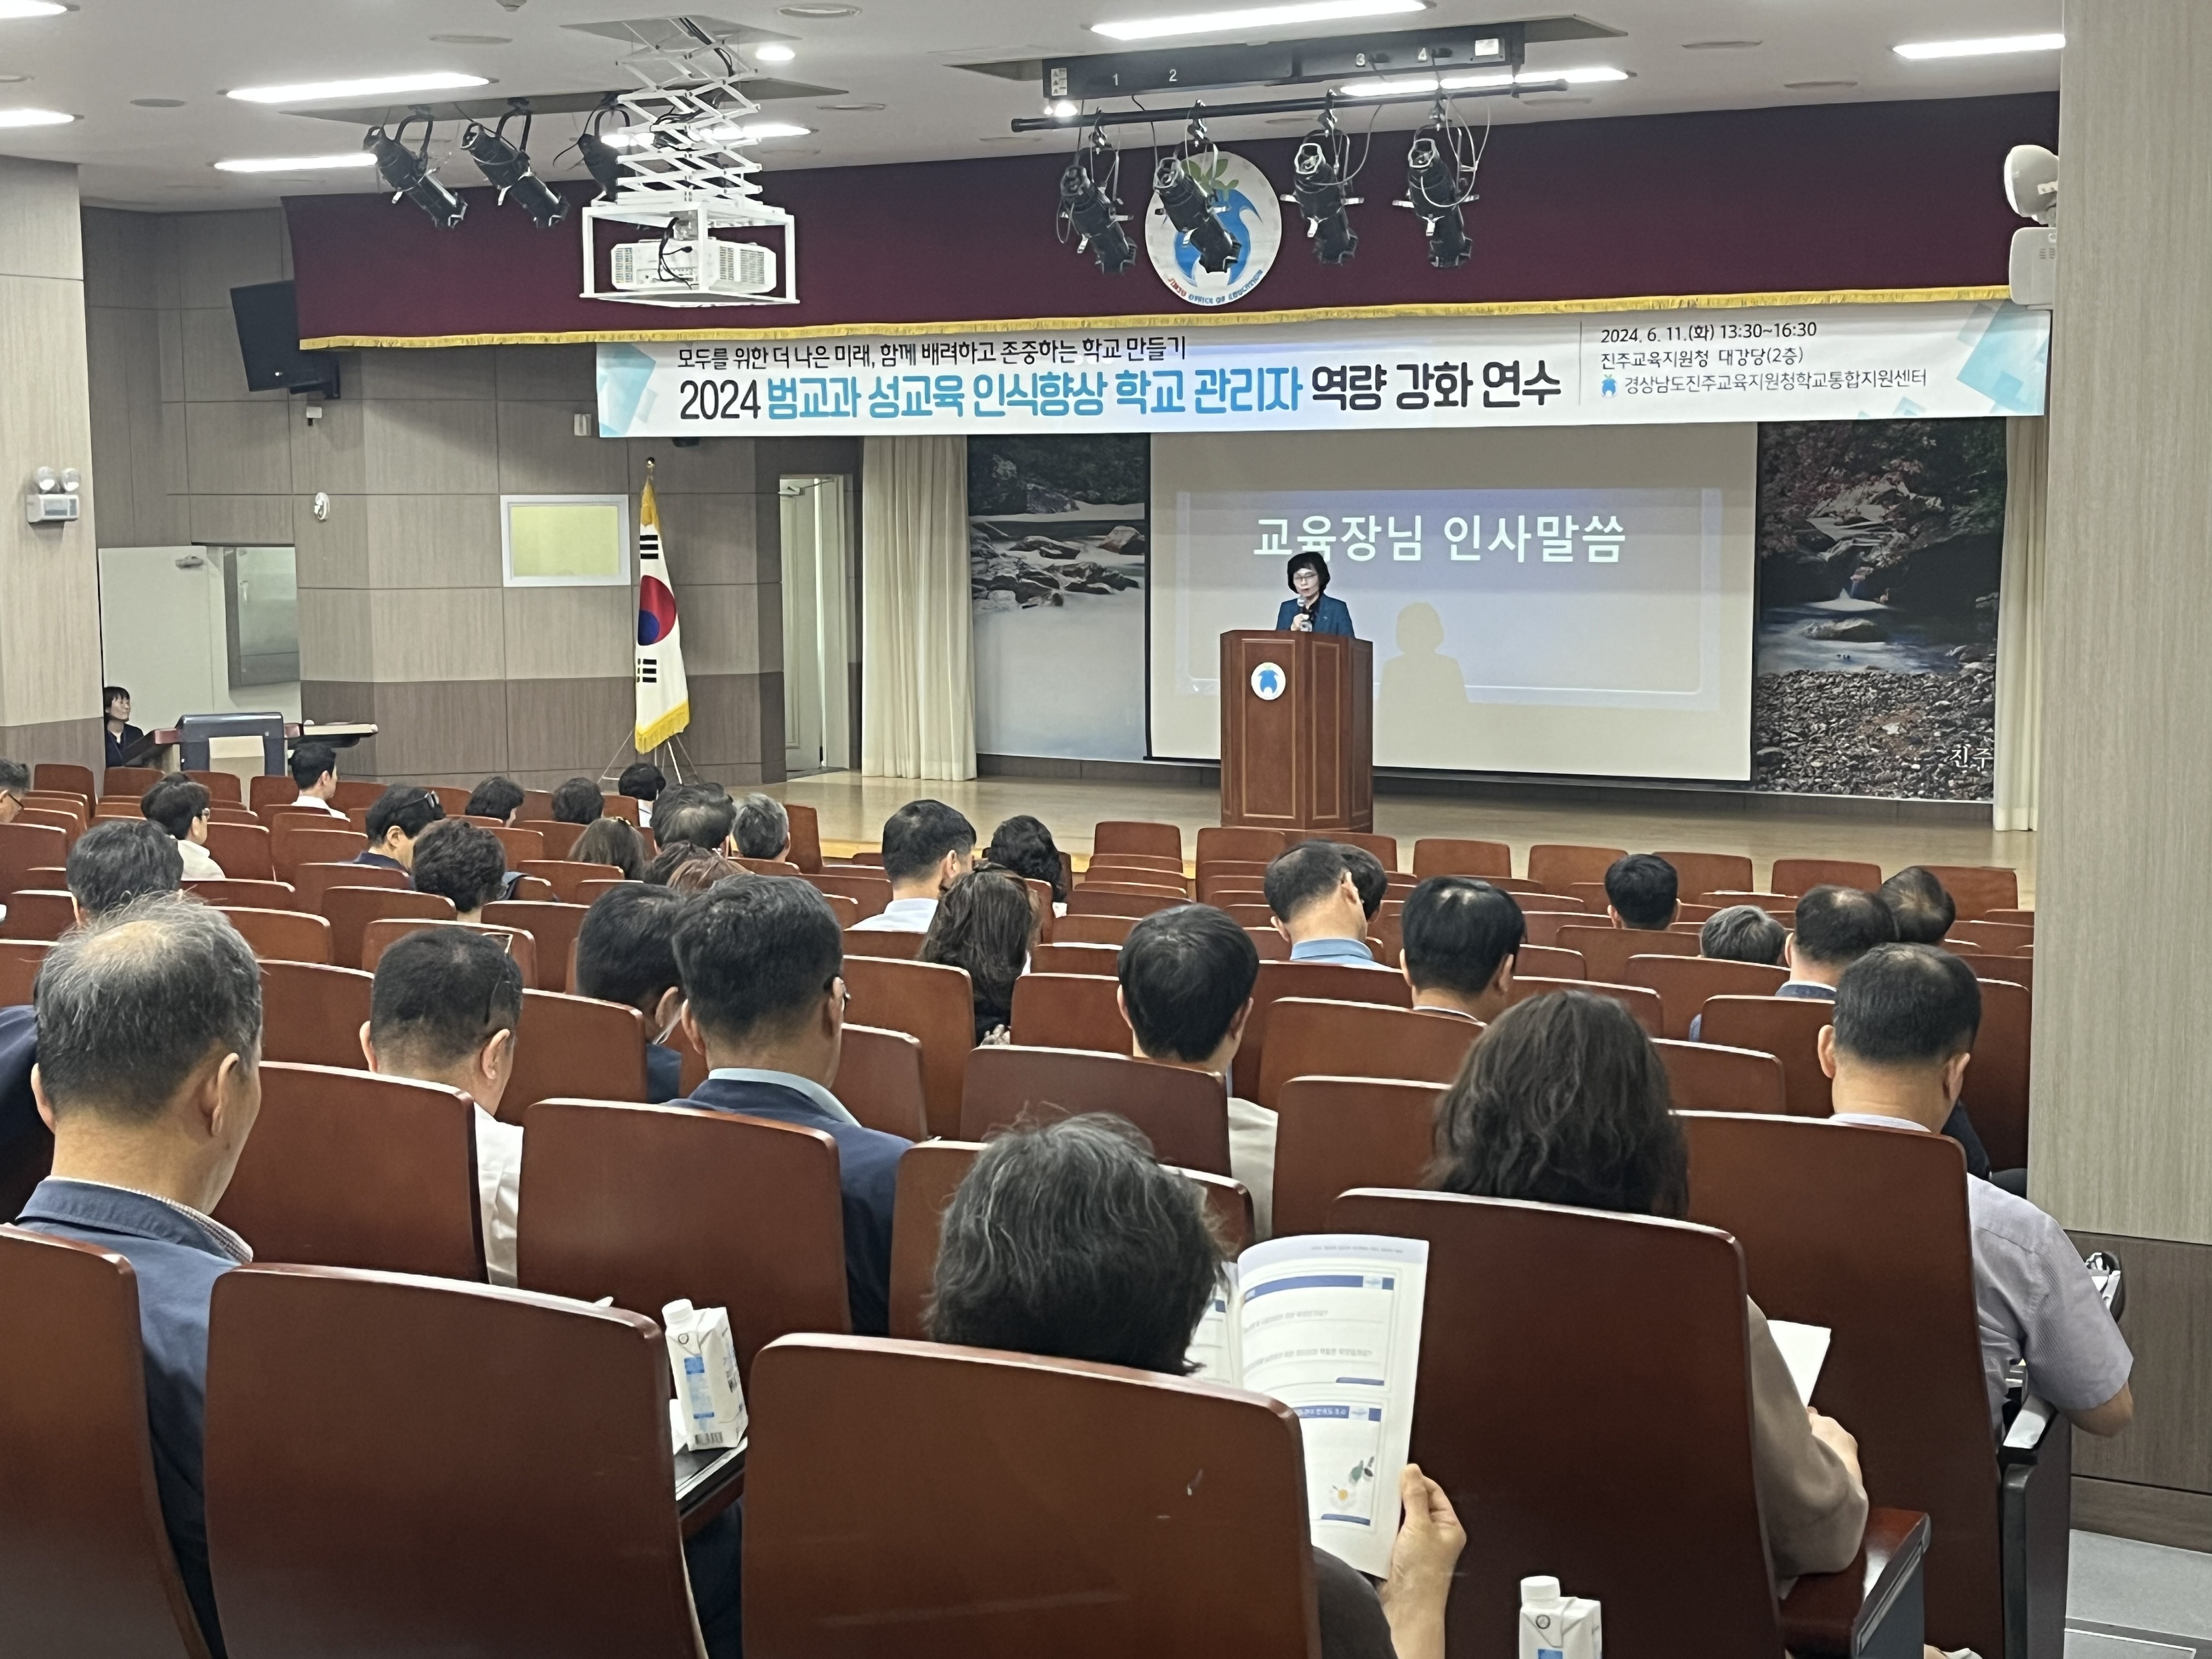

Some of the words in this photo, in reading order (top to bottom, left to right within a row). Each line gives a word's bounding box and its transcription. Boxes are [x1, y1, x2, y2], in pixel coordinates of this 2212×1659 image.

[1720, 321, 1818, 339] 13:30~16:30
[677, 346, 729, 370] 모두를
[732, 345, 769, 370] 위한
[772, 345, 790, 369] 더
[794, 345, 831, 369] 나은
[834, 344, 876, 369] 미래,
[879, 343, 917, 368] 함께
[921, 341, 997, 366] 배려하고
[1000, 339, 1079, 365] 존중하는
[1082, 337, 1122, 363] 학교
[1126, 336, 1186, 362] 만들기
[1601, 349, 1709, 370] 진주교육지원청
[1718, 346, 1803, 366] 대강당(2층)
[680, 379, 761, 420] 2024
[767, 376, 862, 420] 범교과
[868, 375, 966, 419] 성교육
[973, 371, 1109, 417] 인식향상
[1115, 369, 1186, 415] 학교
[1194, 366, 1304, 414] 관리자
[1312, 363, 1387, 411] 역량
[1396, 360, 1474, 410] 강화
[1482, 359, 1562, 408] 연수
[1624, 368, 1926, 394] 경상남도진주교육지원청학교통합지원센터
[1253, 515, 1423, 562] 교육장님
[1443, 515, 1627, 564] 인사말씀
[1950, 743, 1994, 769] 진주
